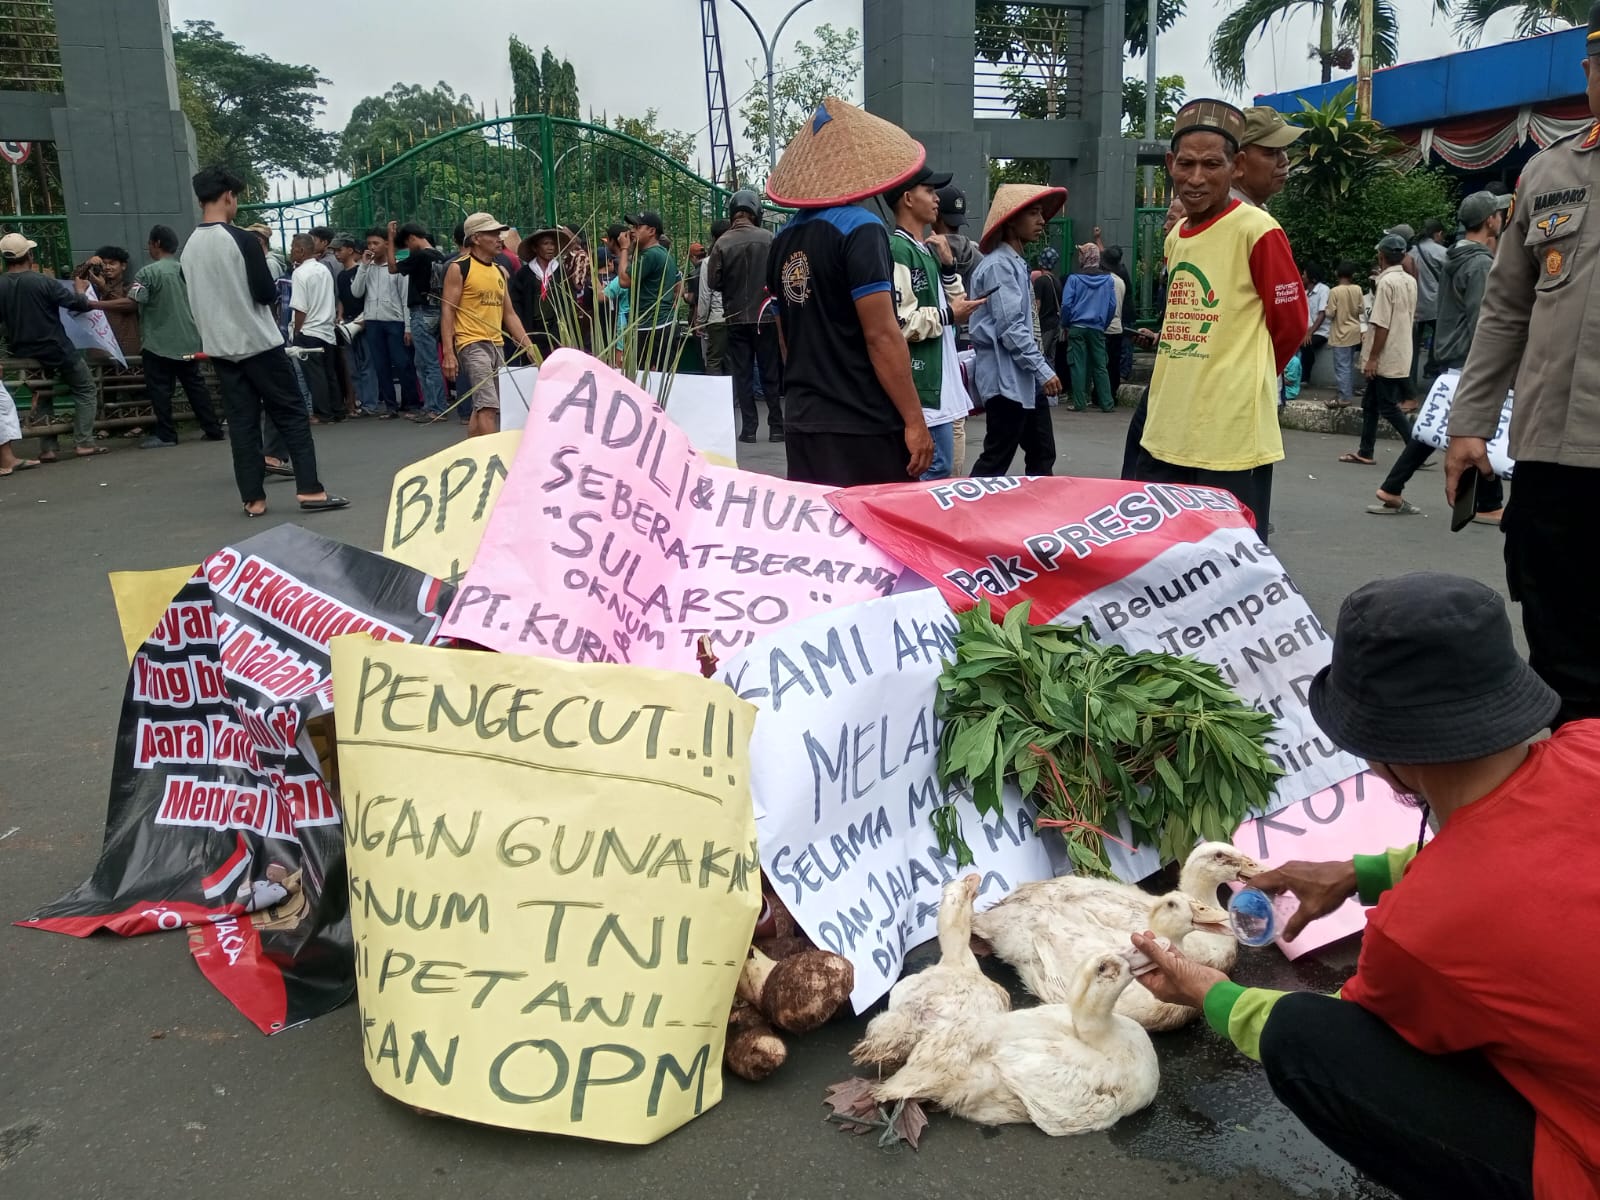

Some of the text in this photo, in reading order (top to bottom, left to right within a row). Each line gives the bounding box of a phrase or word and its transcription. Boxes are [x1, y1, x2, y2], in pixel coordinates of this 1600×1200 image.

[715, 481, 869, 545] HUKU
[448, 585, 511, 632] PT.
[563, 568, 665, 651] OKNUM
[946, 555, 1037, 600] Pak
[1100, 559, 1223, 632] Belum
[1225, 540, 1273, 568] Me
[726, 622, 874, 713] KAMI
[140, 723, 205, 764] para
[497, 815, 760, 894] GUNAKAN
[770, 805, 893, 906] SELAMA
[818, 897, 873, 957] DAN
[488, 1037, 711, 1123] OPM
